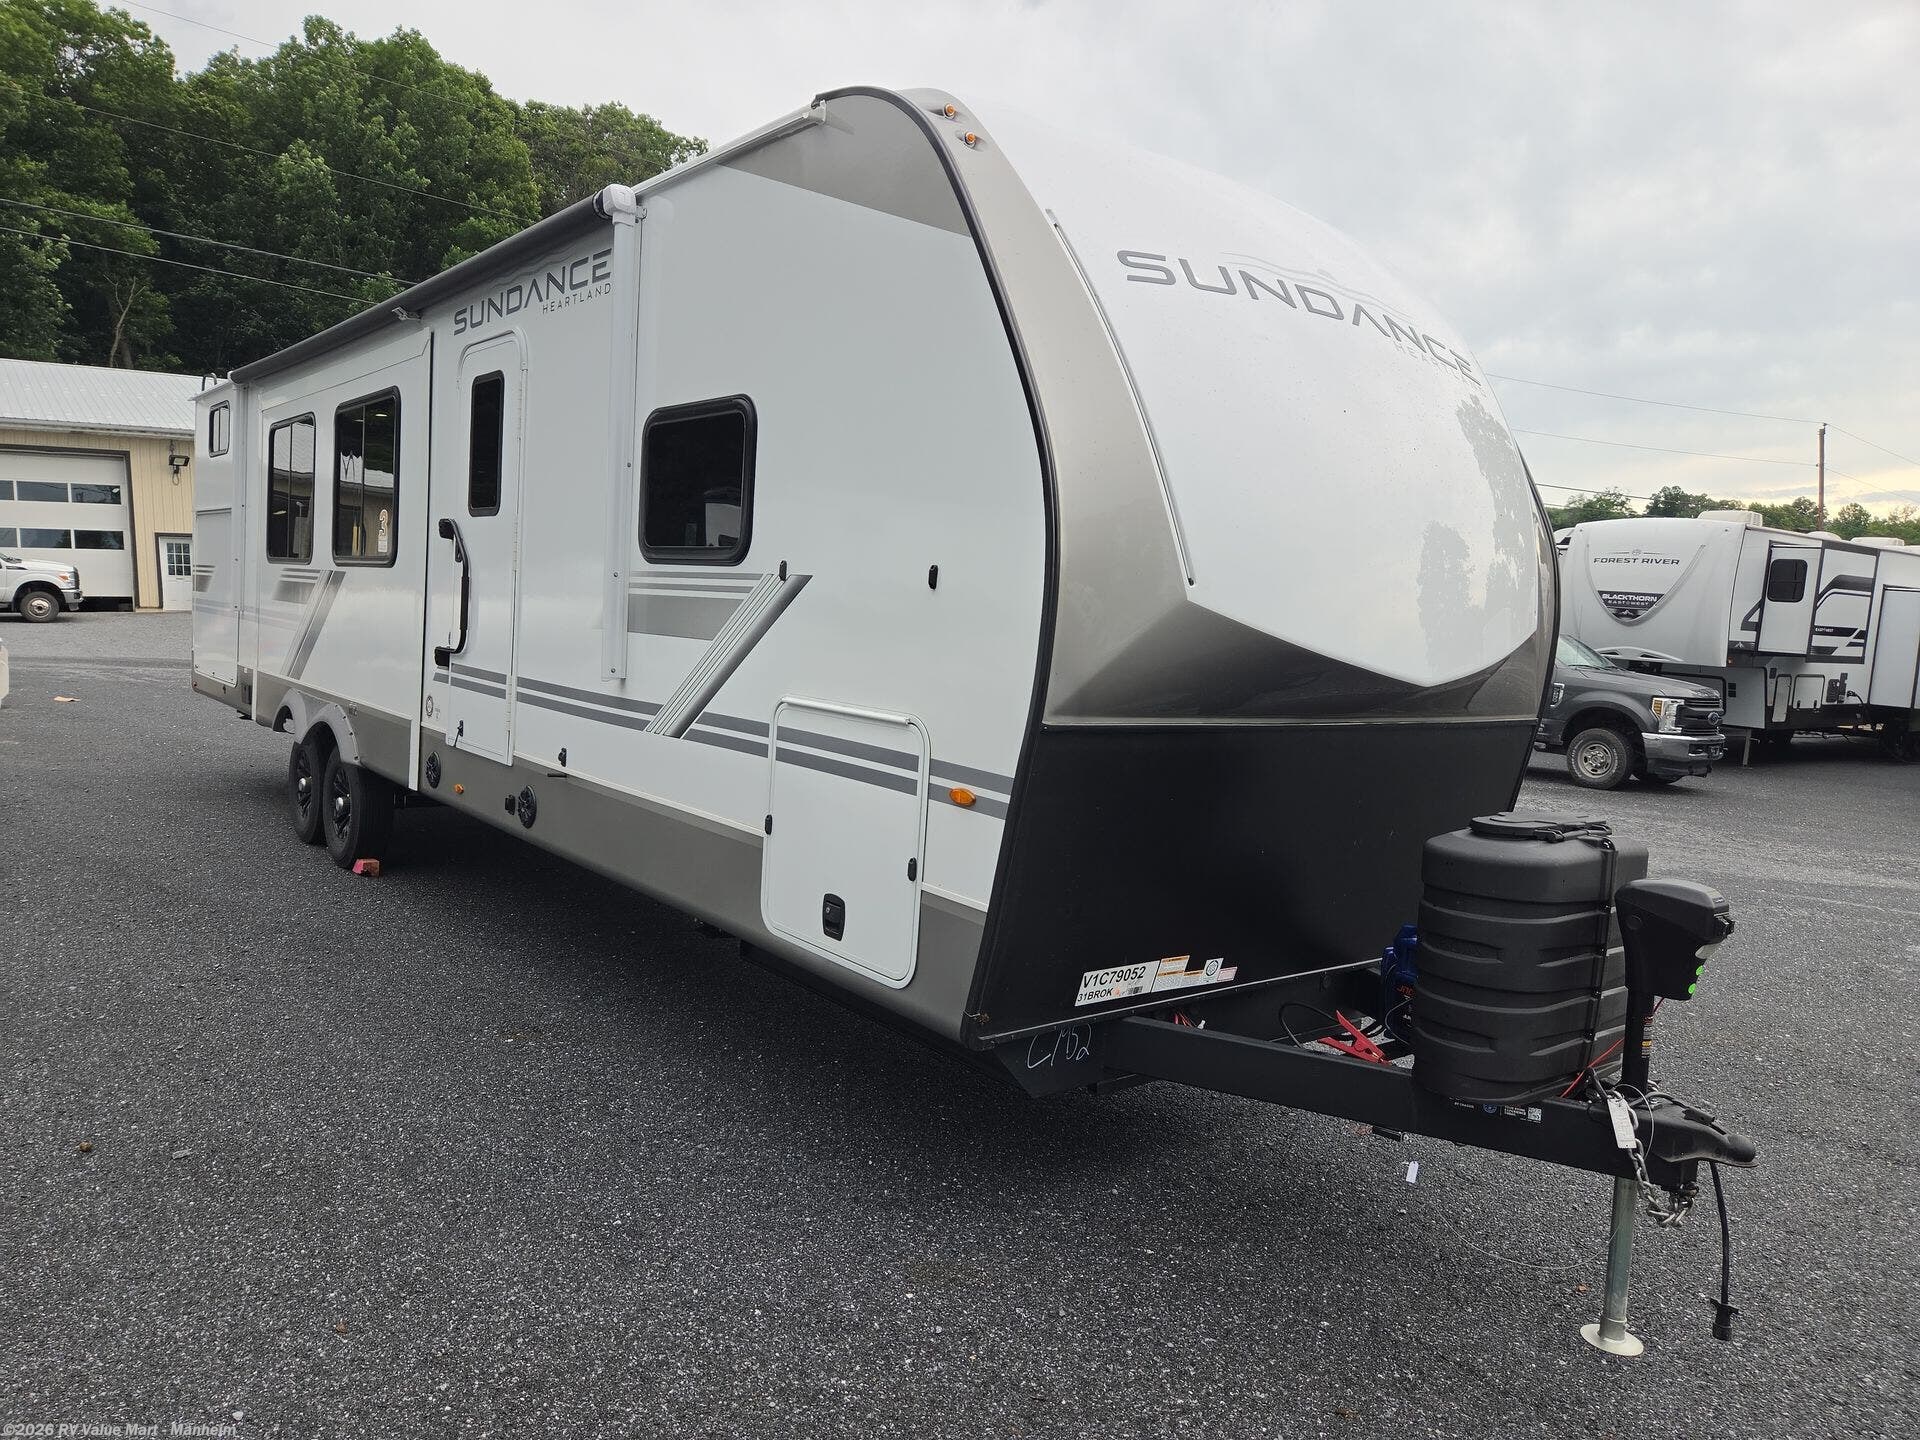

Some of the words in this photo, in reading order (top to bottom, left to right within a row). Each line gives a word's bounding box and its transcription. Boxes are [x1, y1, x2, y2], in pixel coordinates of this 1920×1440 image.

[453, 248, 612, 336] SUNDANCE
[542, 282, 612, 315] HEARTLAND
[1116, 249, 1482, 387] SUNDANCE
[1641, 557, 1680, 565] RIVER
[1601, 593, 1658, 602] BLACKTHORN
[1083, 965, 1146, 988] V1C79052
[1077, 987, 1114, 1002] 31BROK
